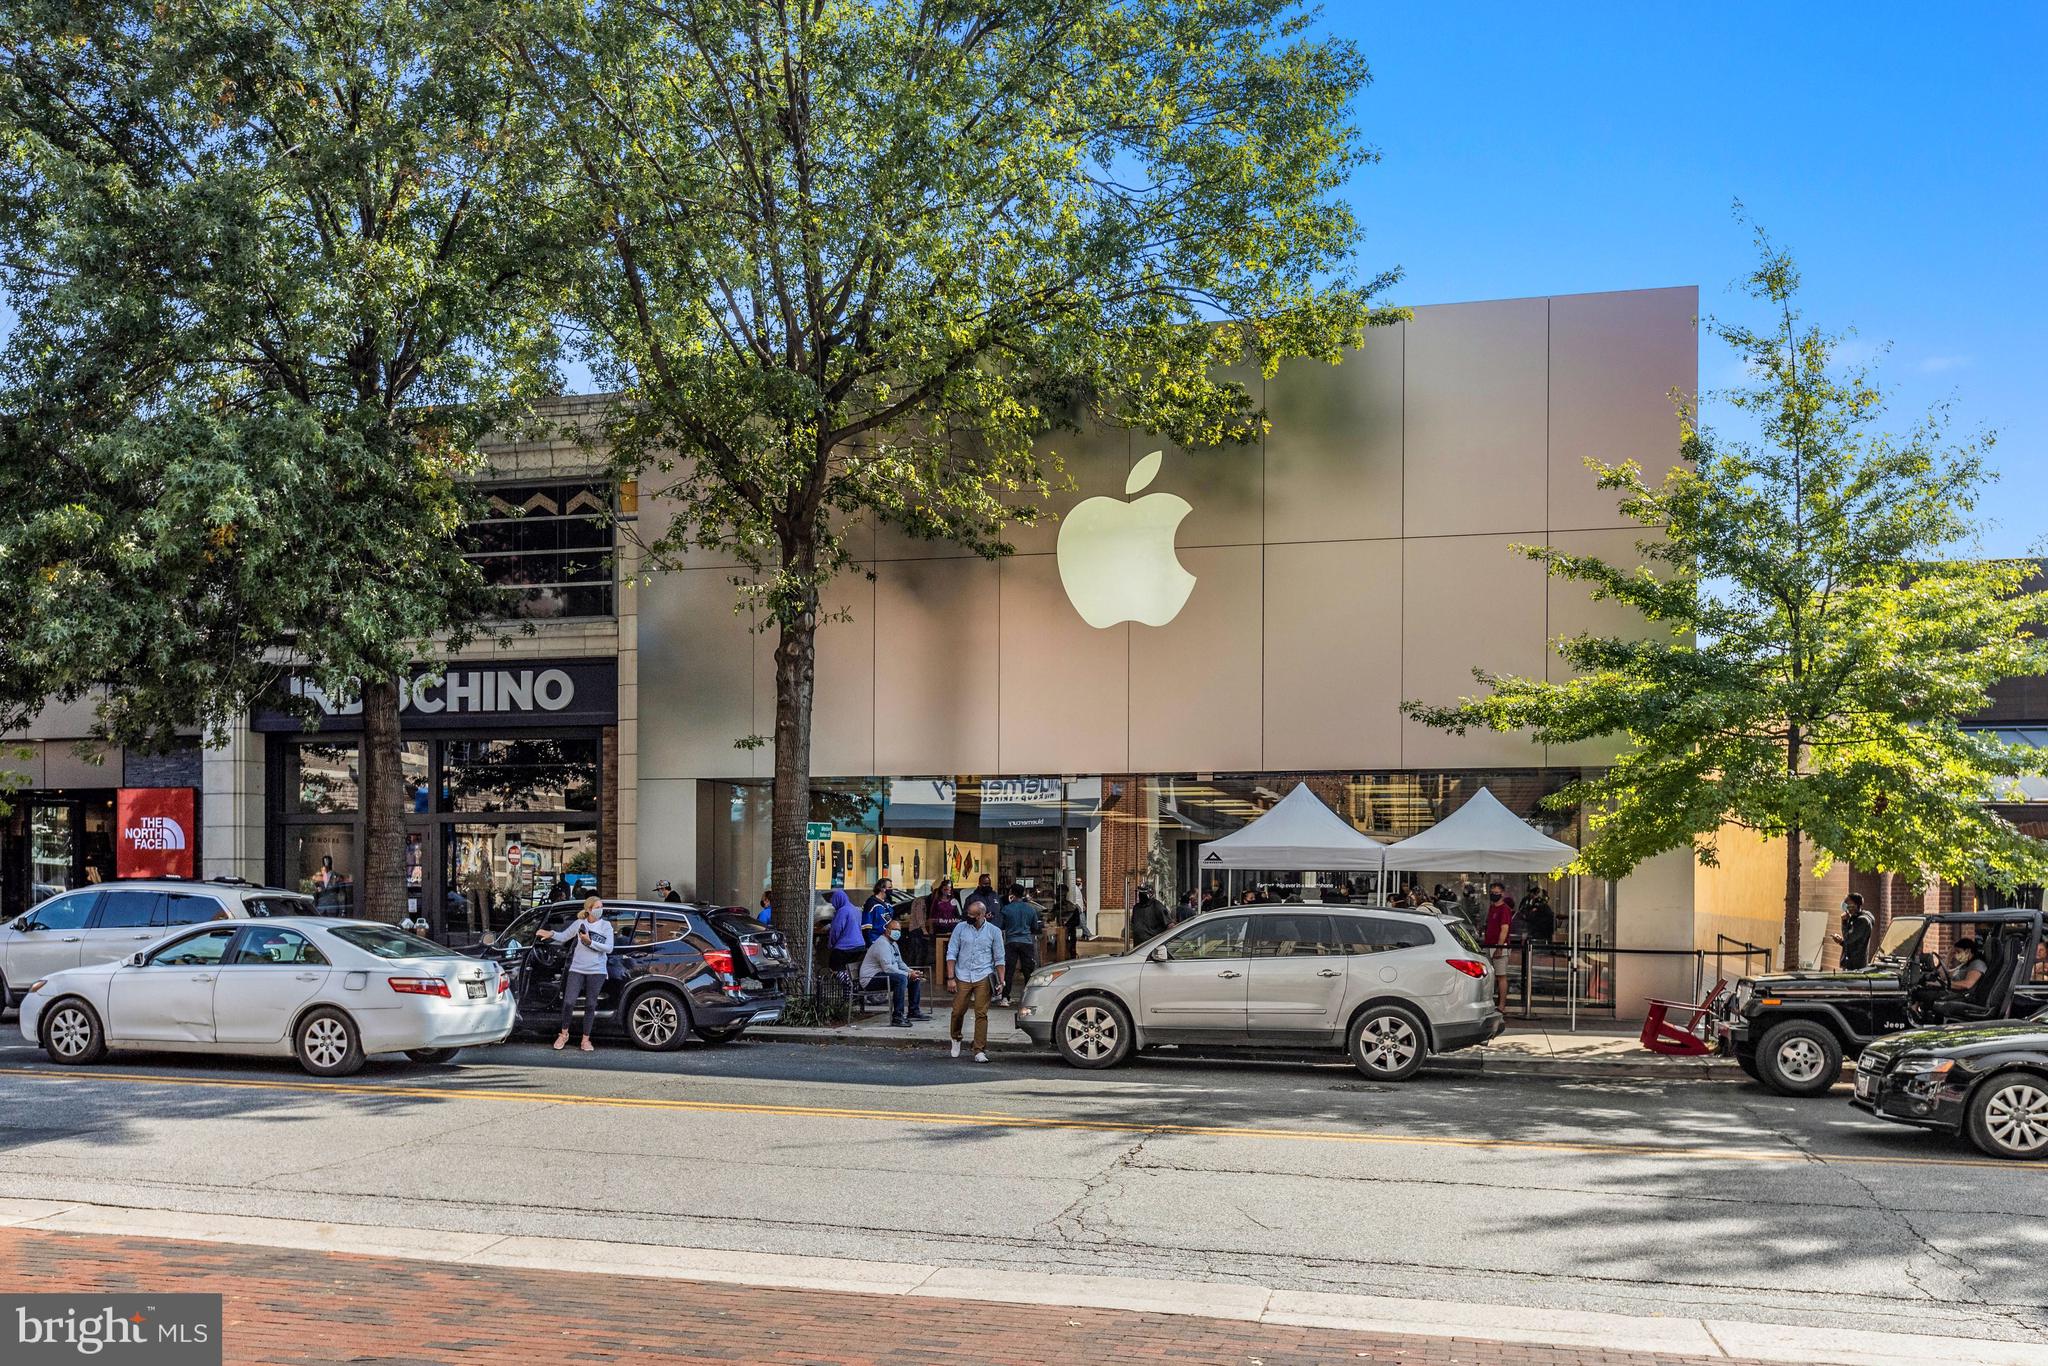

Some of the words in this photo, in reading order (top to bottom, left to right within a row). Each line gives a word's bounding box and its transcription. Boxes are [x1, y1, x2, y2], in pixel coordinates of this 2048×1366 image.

[289, 669, 575, 715] INDCHINO
[140, 816, 163, 828] THE
[125, 828, 163, 839] NORTH
[134, 839, 163, 850] FACE
[1884, 1021, 1906, 1029] Jeep
